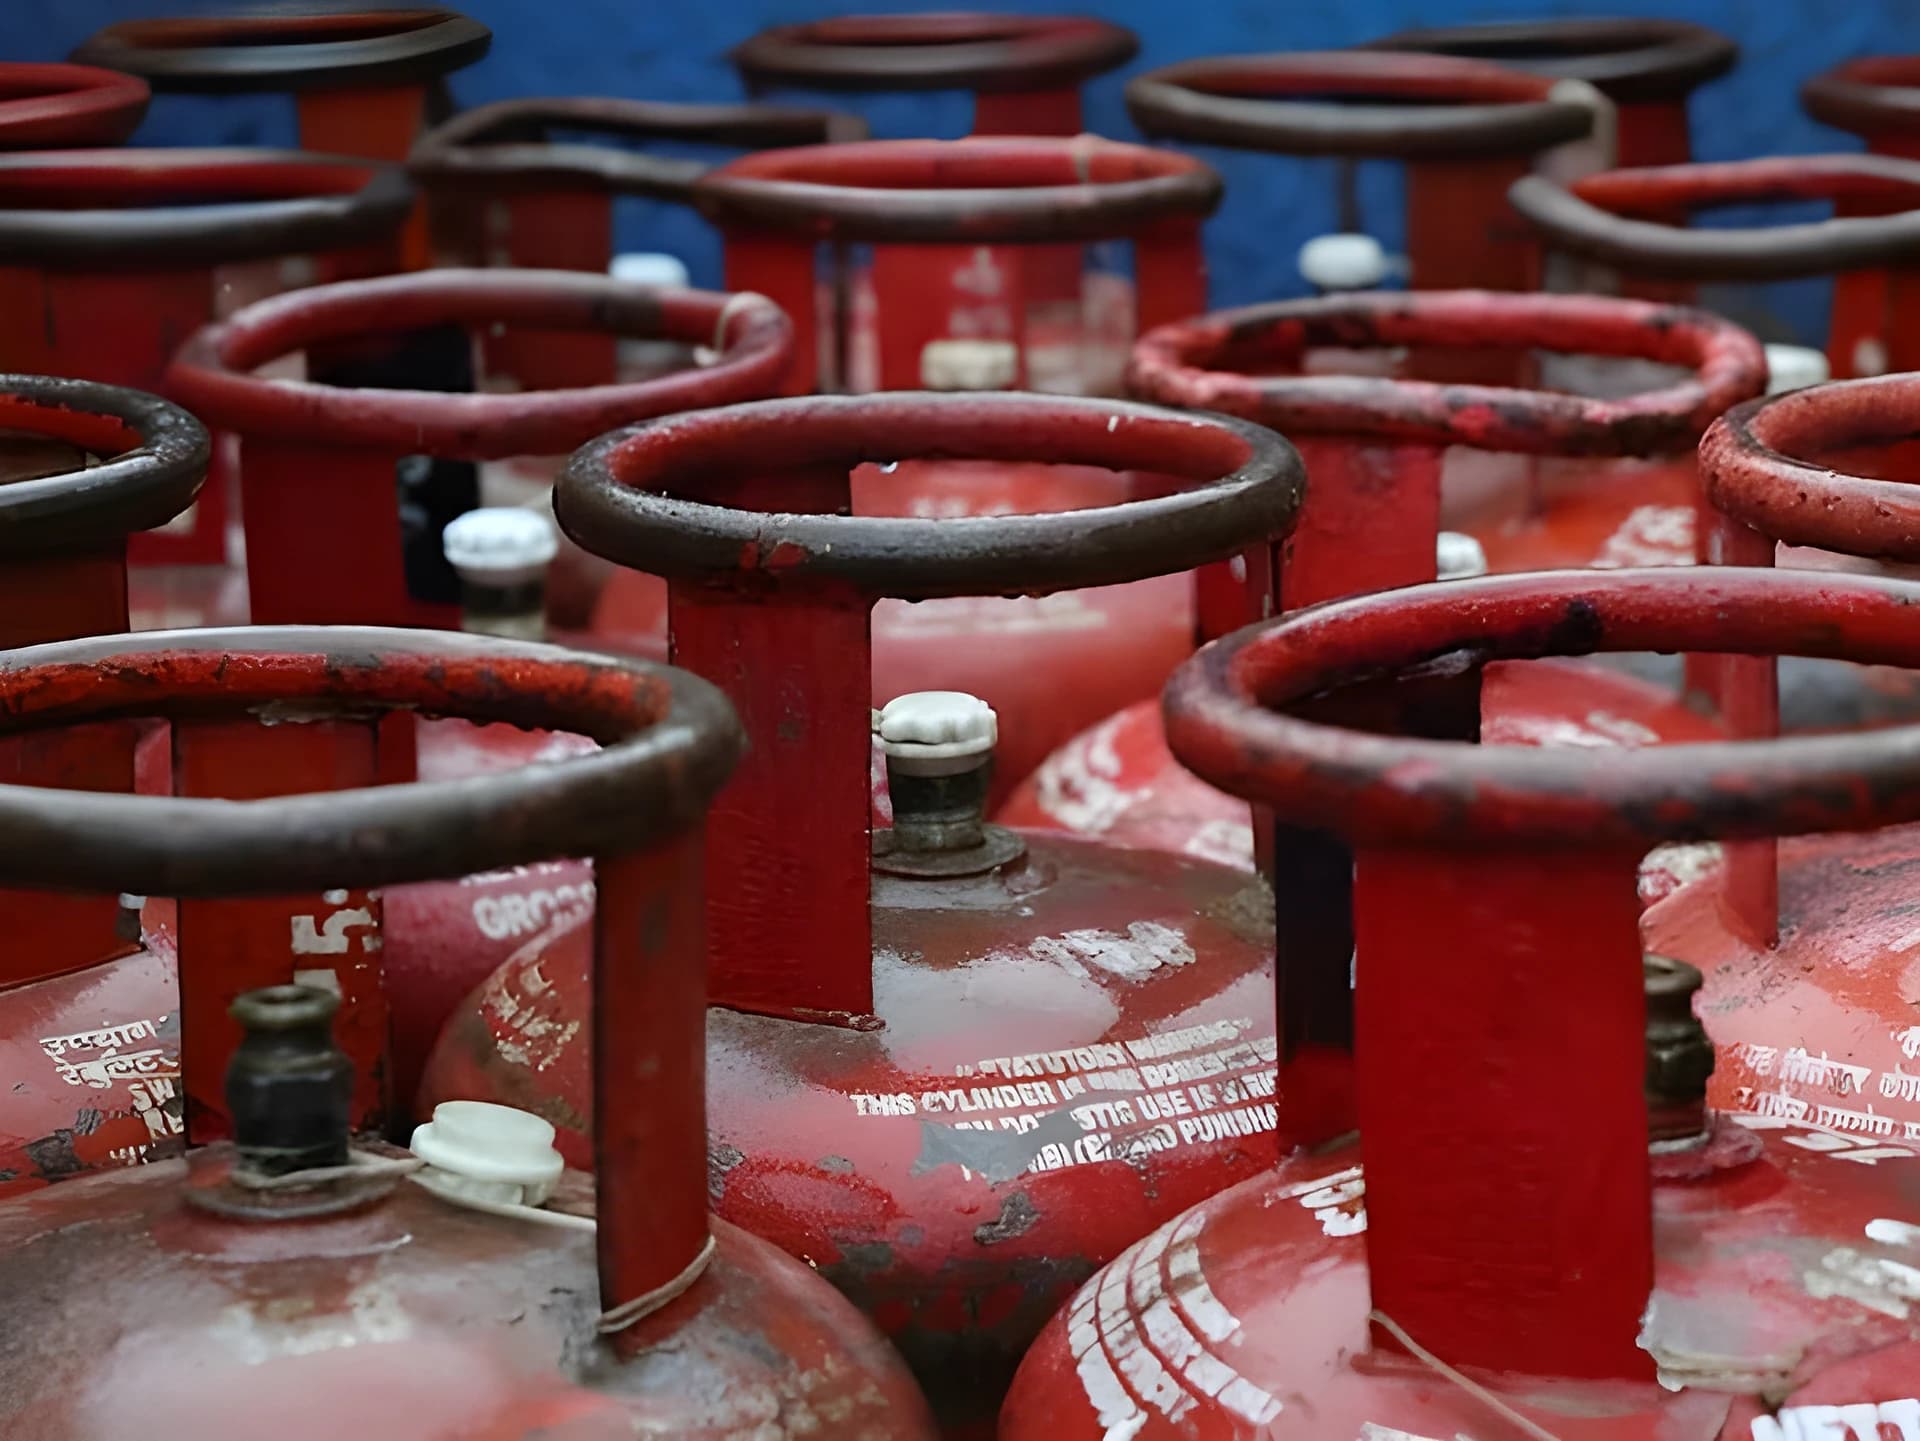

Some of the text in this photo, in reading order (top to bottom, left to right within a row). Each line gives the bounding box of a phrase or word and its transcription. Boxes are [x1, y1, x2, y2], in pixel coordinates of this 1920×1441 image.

[849, 1092, 916, 1116] THIS
[921, 1080, 1058, 1112] CYLINDER
[1136, 1089, 1193, 1121] USE
